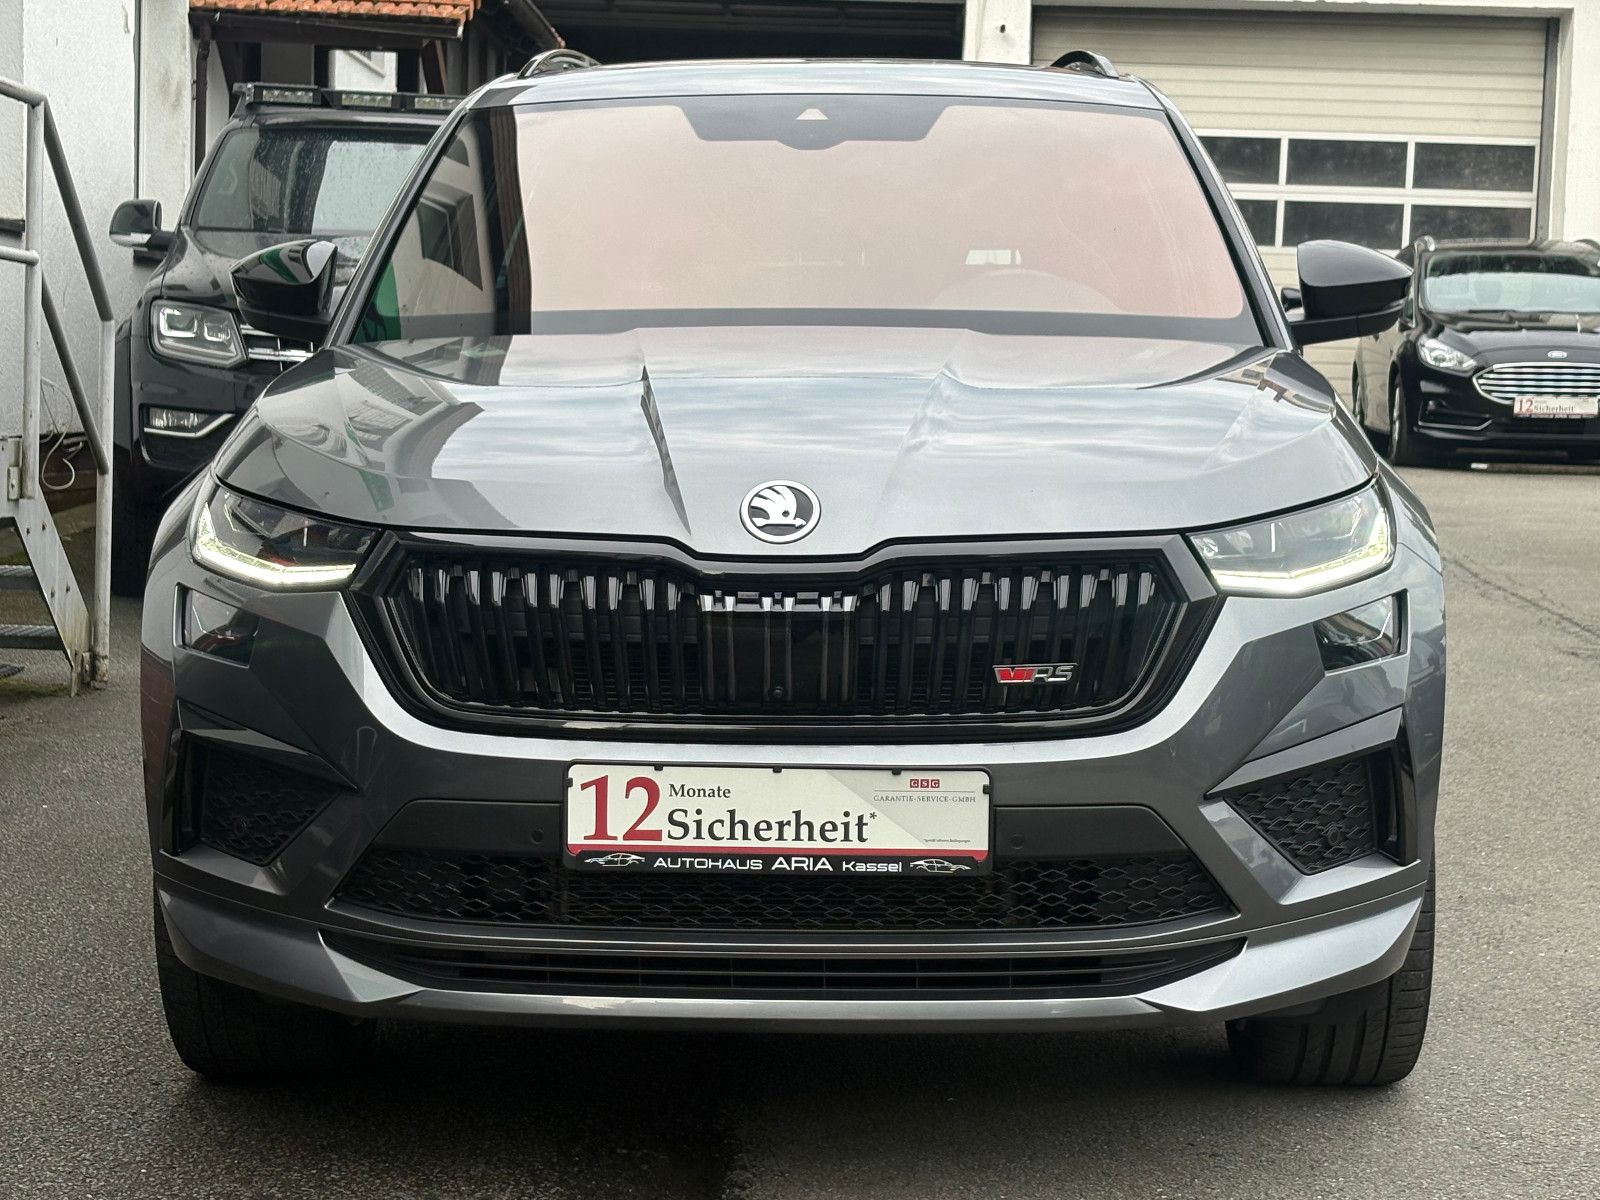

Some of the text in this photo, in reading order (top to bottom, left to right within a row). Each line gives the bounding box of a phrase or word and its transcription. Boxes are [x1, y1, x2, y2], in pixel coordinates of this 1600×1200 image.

[1518, 399, 1533, 412] 12
[668, 783, 731, 798] Monate
[910, 779, 940, 788] GSG
[580, 775, 662, 841] 12
[653, 857, 902, 872] AUTOHAUS ARIA Kassel
